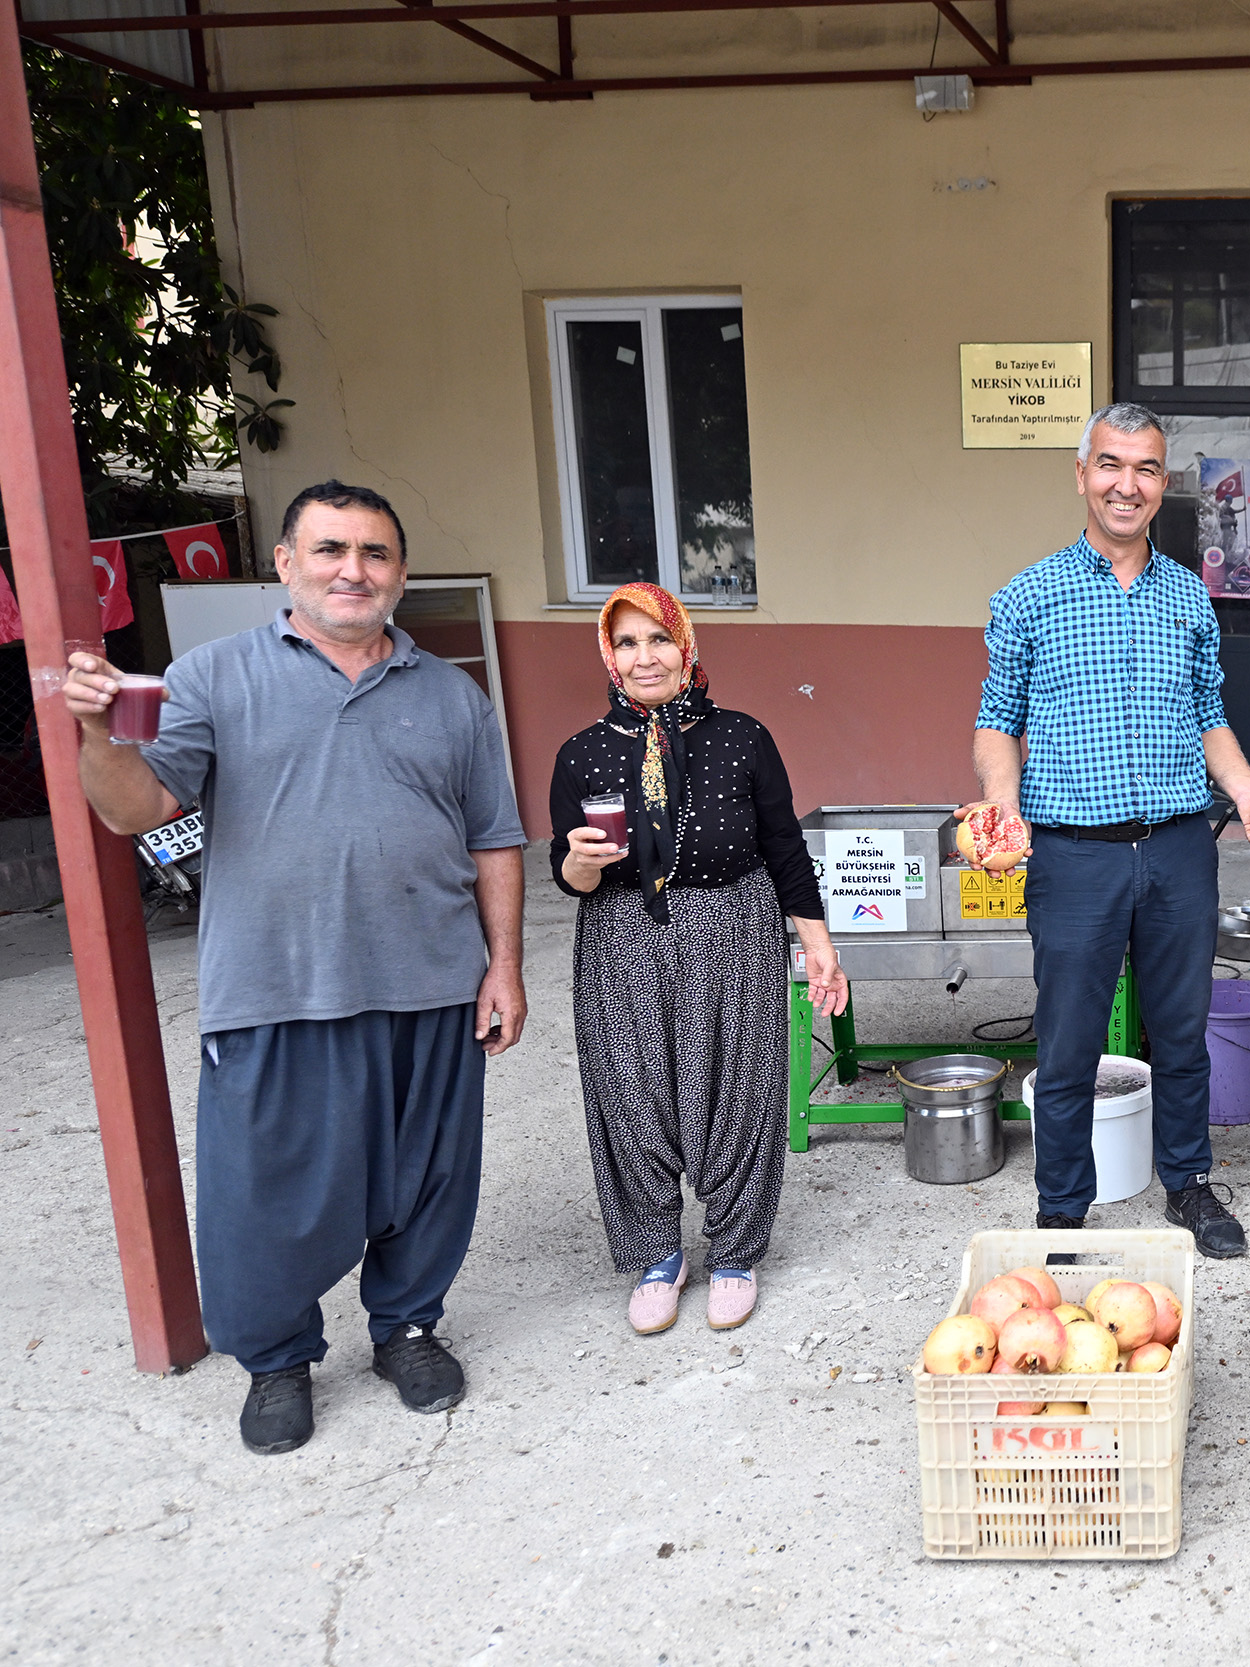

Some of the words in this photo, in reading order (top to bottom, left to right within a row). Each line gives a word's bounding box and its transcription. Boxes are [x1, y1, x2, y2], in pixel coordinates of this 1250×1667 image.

[995, 360, 1008, 369] Bu
[1010, 360, 1039, 371] Taziye
[1042, 360, 1056, 369] Evi
[971, 376, 1022, 389] MERSİN
[1025, 376, 1081, 389] VALİLİĞİ
[1008, 393, 1046, 405] YİKOB
[971, 414, 1020, 423] Tarafından
[1021, 414, 1084, 424] Yaptırılmıştır.
[1019, 433, 1036, 441] 2019
[855, 836, 874, 844] T.C.
[847, 847, 884, 857] MERSİN
[835, 860, 896, 872] BÜYÜKŞEHİR
[841, 873, 891, 883] BELEDİYESİ
[832, 886, 902, 897] ARMAĞANIDIR
